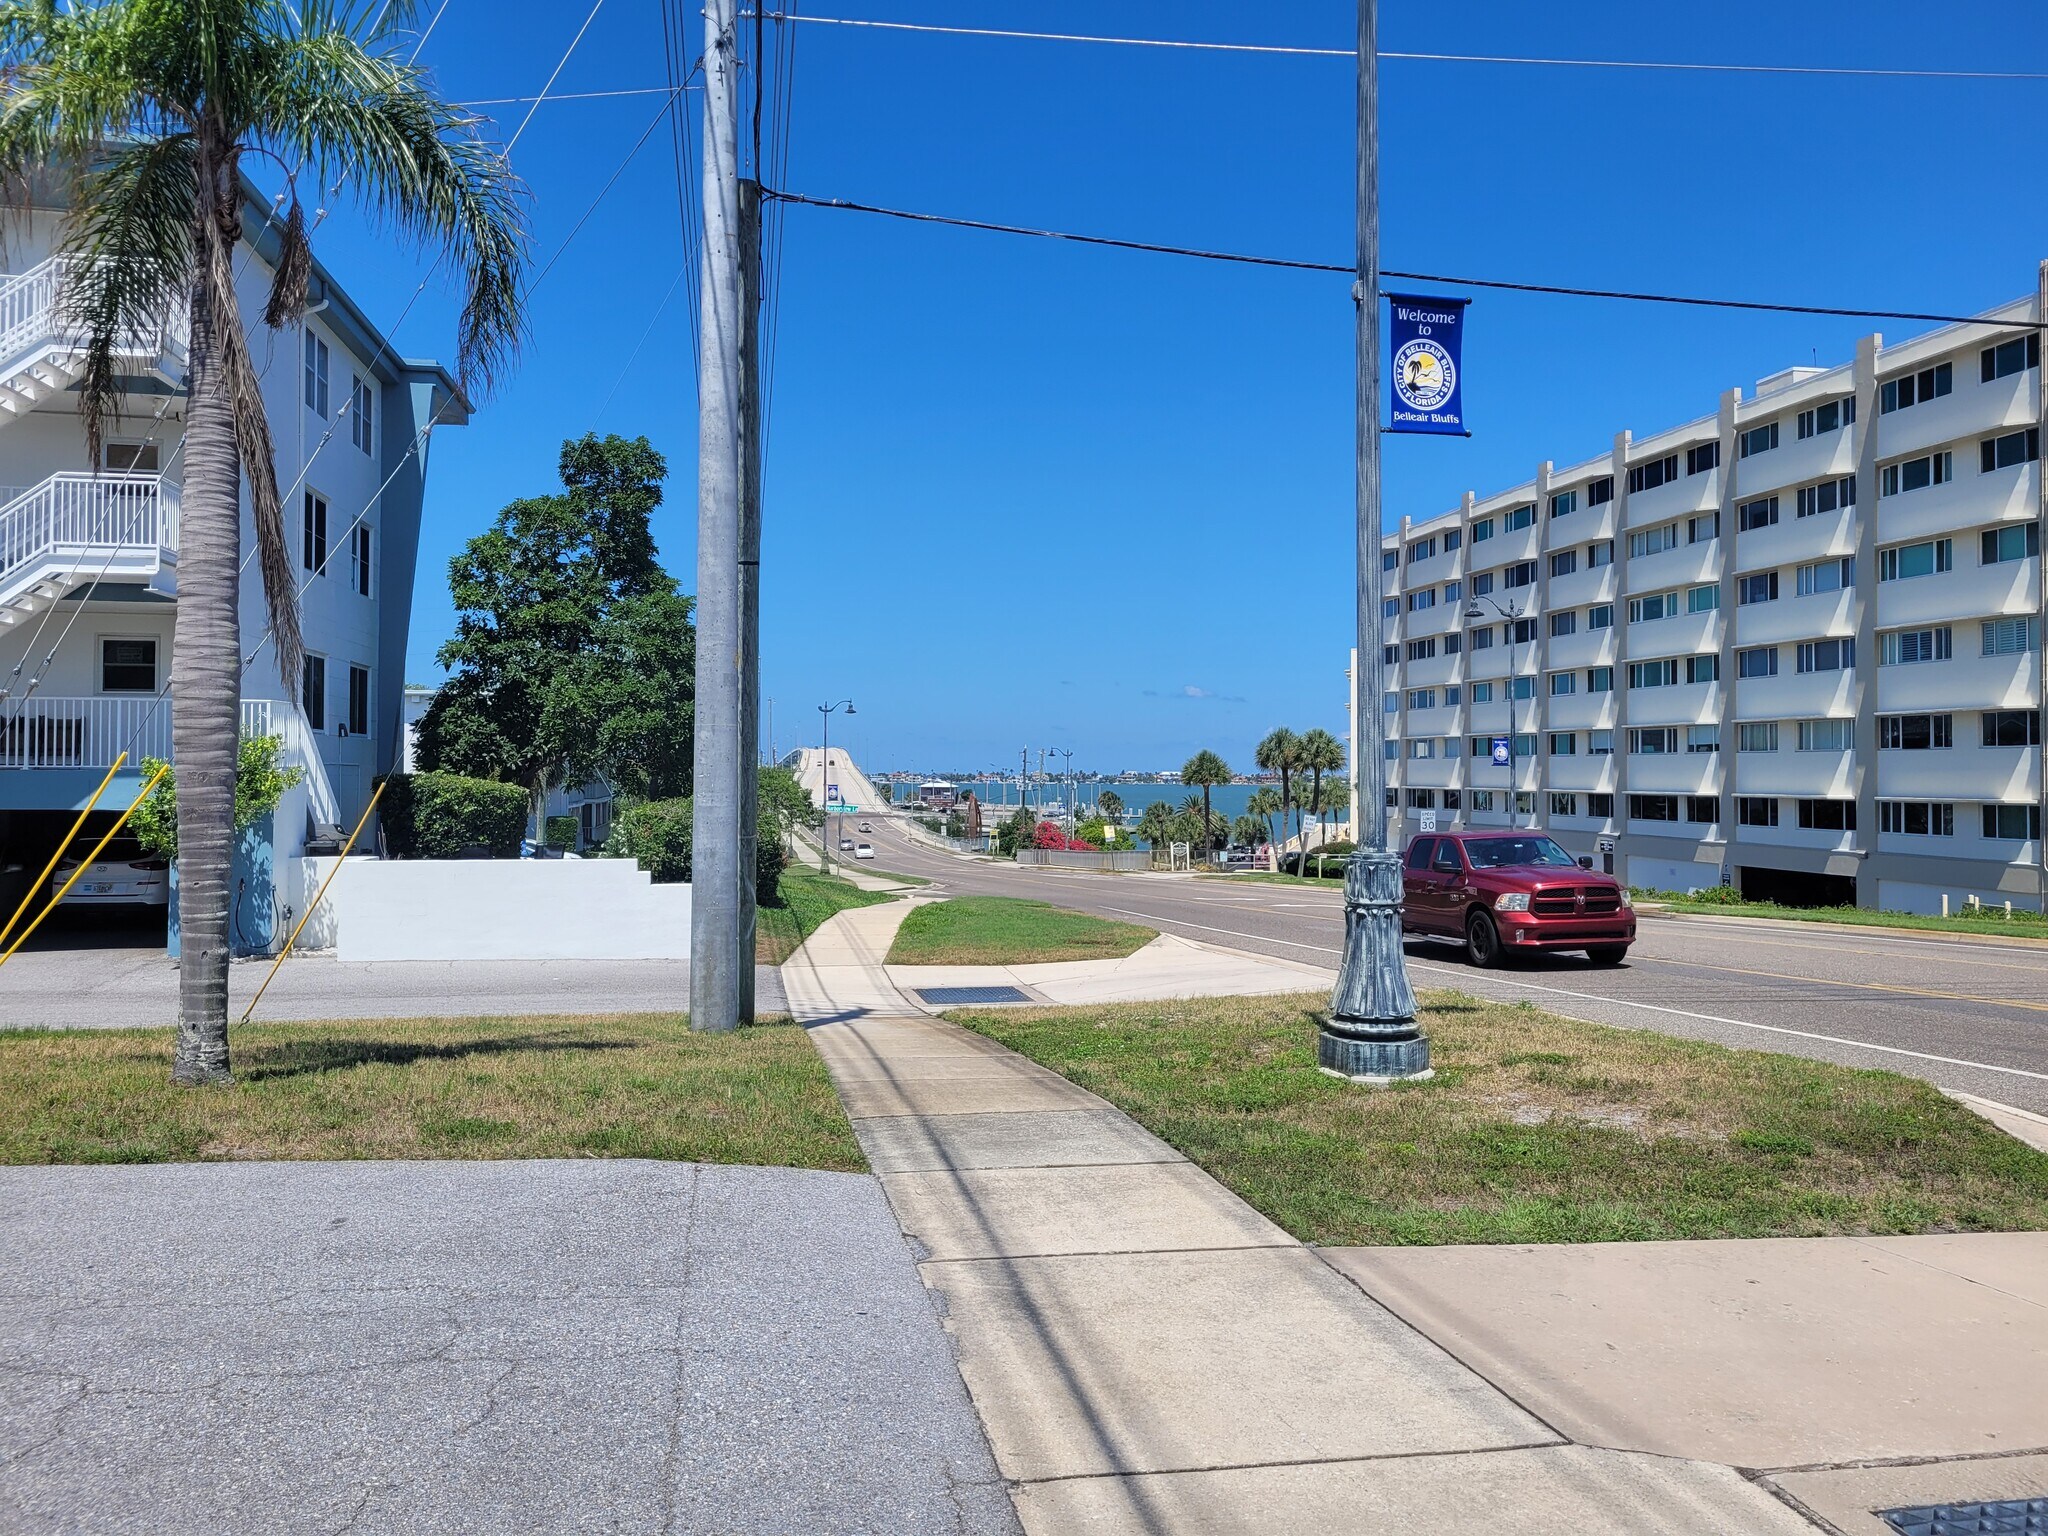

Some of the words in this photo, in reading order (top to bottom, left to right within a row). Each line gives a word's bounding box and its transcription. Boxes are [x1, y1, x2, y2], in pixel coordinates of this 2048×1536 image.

[1397, 307, 1456, 324] Welcome
[1418, 323, 1432, 336] to
[1405, 344, 1443, 360] BELLEAIR
[1398, 354, 1407, 366] OF
[1396, 367, 1406, 389] CITY
[1440, 359, 1452, 393] BLUFFS
[1405, 391, 1443, 406] FLORIDA
[1393, 411, 1429, 422] Belleair
[1430, 413, 1460, 424] Bluffs
[1421, 821, 1435, 830] 30
